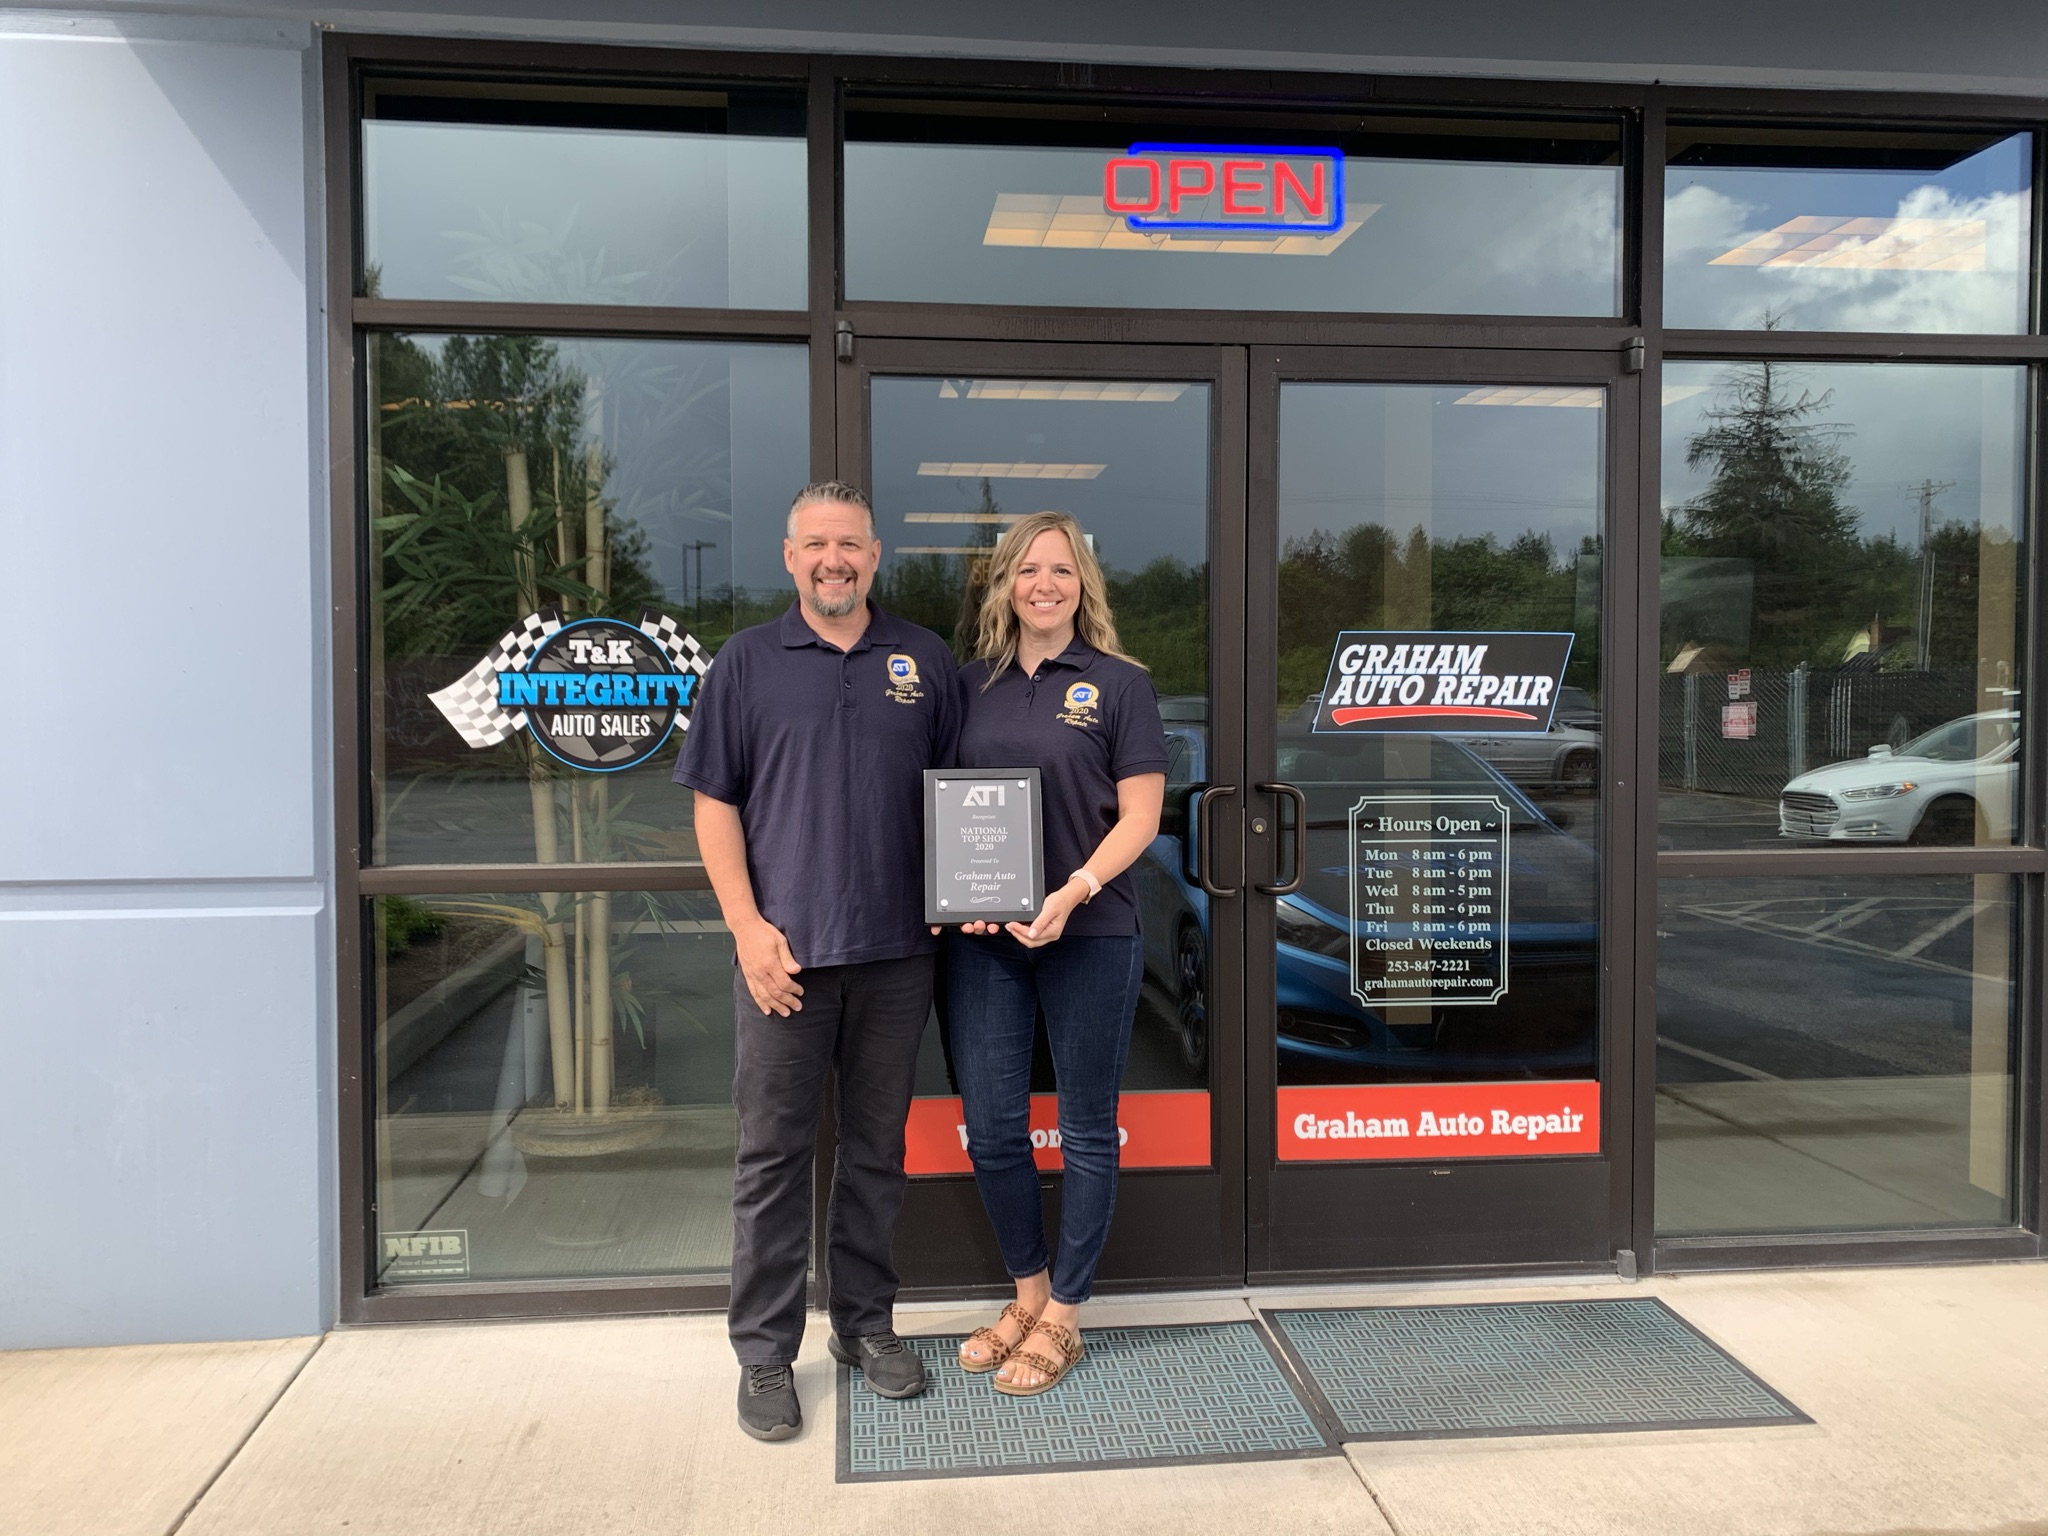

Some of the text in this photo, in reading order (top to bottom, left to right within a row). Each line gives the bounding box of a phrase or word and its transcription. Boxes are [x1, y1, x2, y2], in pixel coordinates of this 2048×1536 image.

[1105, 158, 1325, 217] OPEN
[568, 639, 634, 664] T&K
[1338, 644, 1488, 675] GRAHAM
[893, 662, 910, 672] ATI
[498, 672, 696, 707] INTEGRITY
[1073, 691, 1092, 699] ATI
[1328, 675, 1553, 706] AUTO REPAIR
[1069, 707, 1089, 715] 2020
[551, 714, 651, 737] AUTO SALES
[962, 785, 1005, 807] ATI
[960, 827, 1008, 835] NATIONAL
[1378, 816, 1432, 832] Hours
[1436, 816, 1481, 835] Open
[961, 835, 1007, 843] TOP SHOP
[975, 843, 994, 851] 2020
[1365, 849, 1398, 861] Mon
[1412, 849, 1419, 860] 8
[1423, 851, 1446, 860] am
[1458, 849, 1465, 860] 6
[1468, 851, 1492, 862] pm
[954, 871, 1016, 881] Graham Auto
[1365, 867, 1393, 879] Tue
[1412, 867, 1419, 878] 8
[1423, 869, 1446, 878] am
[1458, 867, 1465, 878] 6
[1468, 869, 1492, 880] pm
[970, 882, 1001, 893] Repair
[1365, 884, 1399, 896] Wed
[1412, 885, 1419, 896] 8
[1423, 887, 1446, 896] am
[1458, 885, 1465, 896] 5
[1468, 887, 1492, 898] pm
[1365, 902, 1395, 915] Thu
[1412, 902, 1419, 914] 8
[1423, 904, 1446, 914] am
[1458, 902, 1465, 914] 6
[1468, 904, 1492, 916] pm
[1366, 920, 1388, 933] Fri
[1412, 920, 1419, 932] 8
[1423, 922, 1446, 932] am
[1458, 920, 1465, 932] 6
[1468, 922, 1492, 934] pm
[1365, 937, 1492, 951] Closed Weekends
[1387, 960, 1470, 972] 253-847-2221
[1364, 976, 1493, 991] grahamautorepair.com
[1294, 1107, 1583, 1140] Graham Auto Repair
[384, 1236, 461, 1257] NFIB
